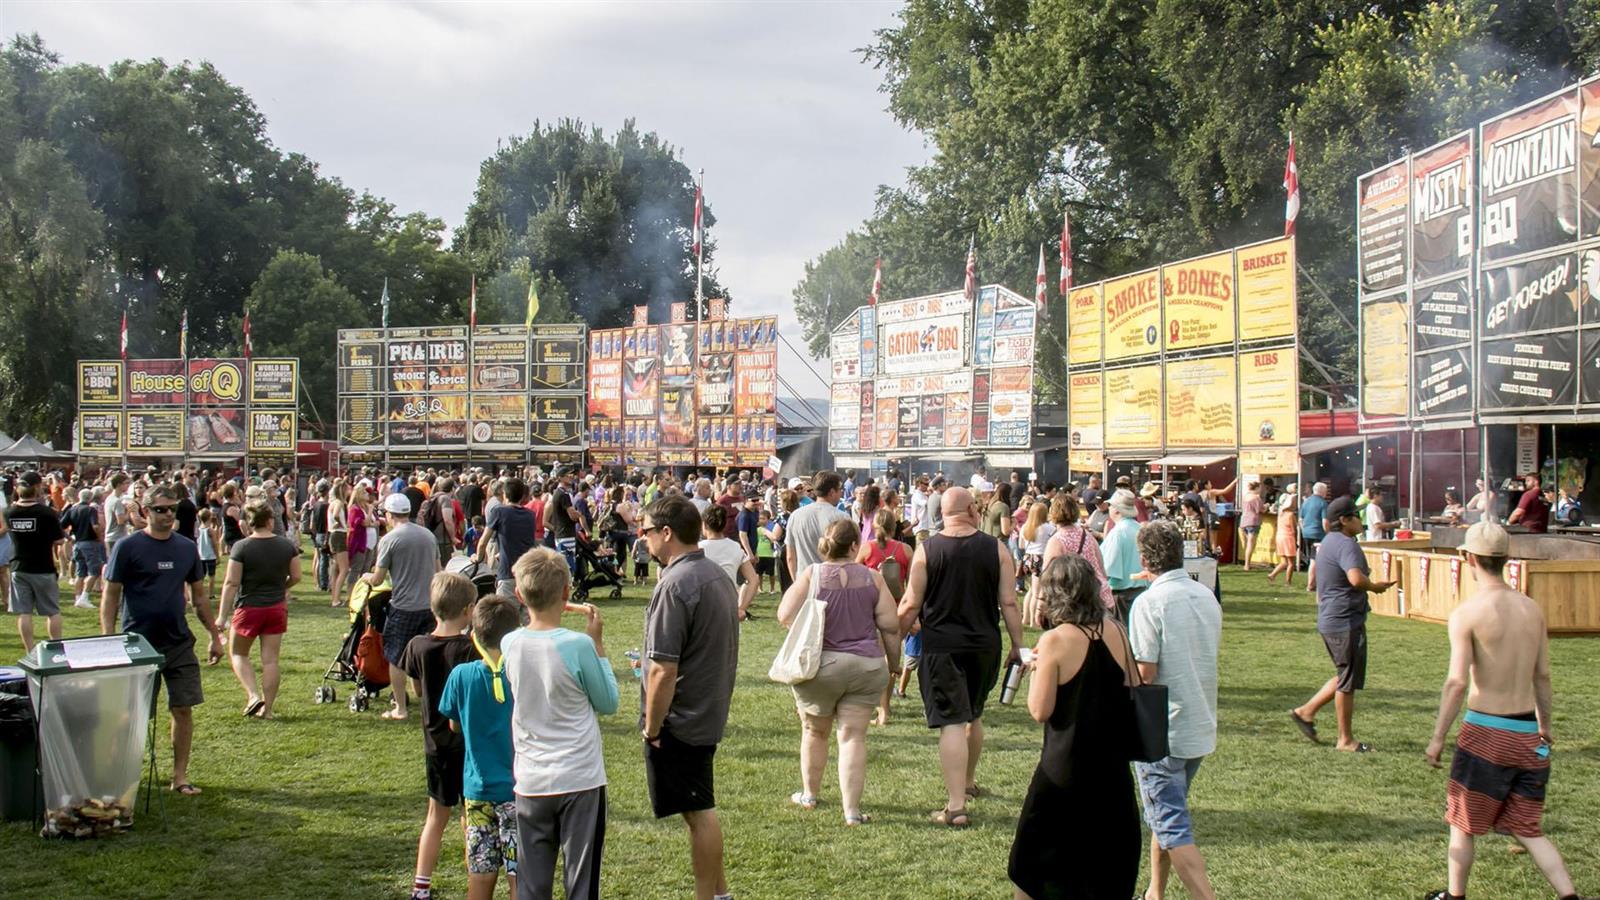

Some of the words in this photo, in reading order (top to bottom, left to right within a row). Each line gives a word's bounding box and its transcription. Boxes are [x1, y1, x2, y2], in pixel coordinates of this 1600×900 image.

[1415, 163, 1463, 224] MISTY
[1466, 120, 1575, 207] MOUNTAIN
[1242, 252, 1288, 271] BRISKET
[1076, 295, 1095, 308] PORK
[1107, 276, 1157, 323] SMOKE
[1164, 277, 1174, 297] &
[1177, 268, 1232, 301] BONES
[888, 331, 919, 357] GATOR
[937, 326, 958, 352] BBQ
[389, 343, 464, 361] PRAIRIE
[1254, 353, 1279, 367] RIBS
[90, 376, 112, 388] BBQ
[131, 370, 185, 393] House
[191, 369, 213, 392] of
[210, 362, 242, 402] Q
[393, 371, 425, 381] SMOKE
[428, 370, 440, 386] &
[440, 376, 465, 385] SPICE
[1072, 375, 1101, 387] CHICKEN
[255, 414, 280, 425] 100+
[255, 440, 290, 448] CHAMPIONS
